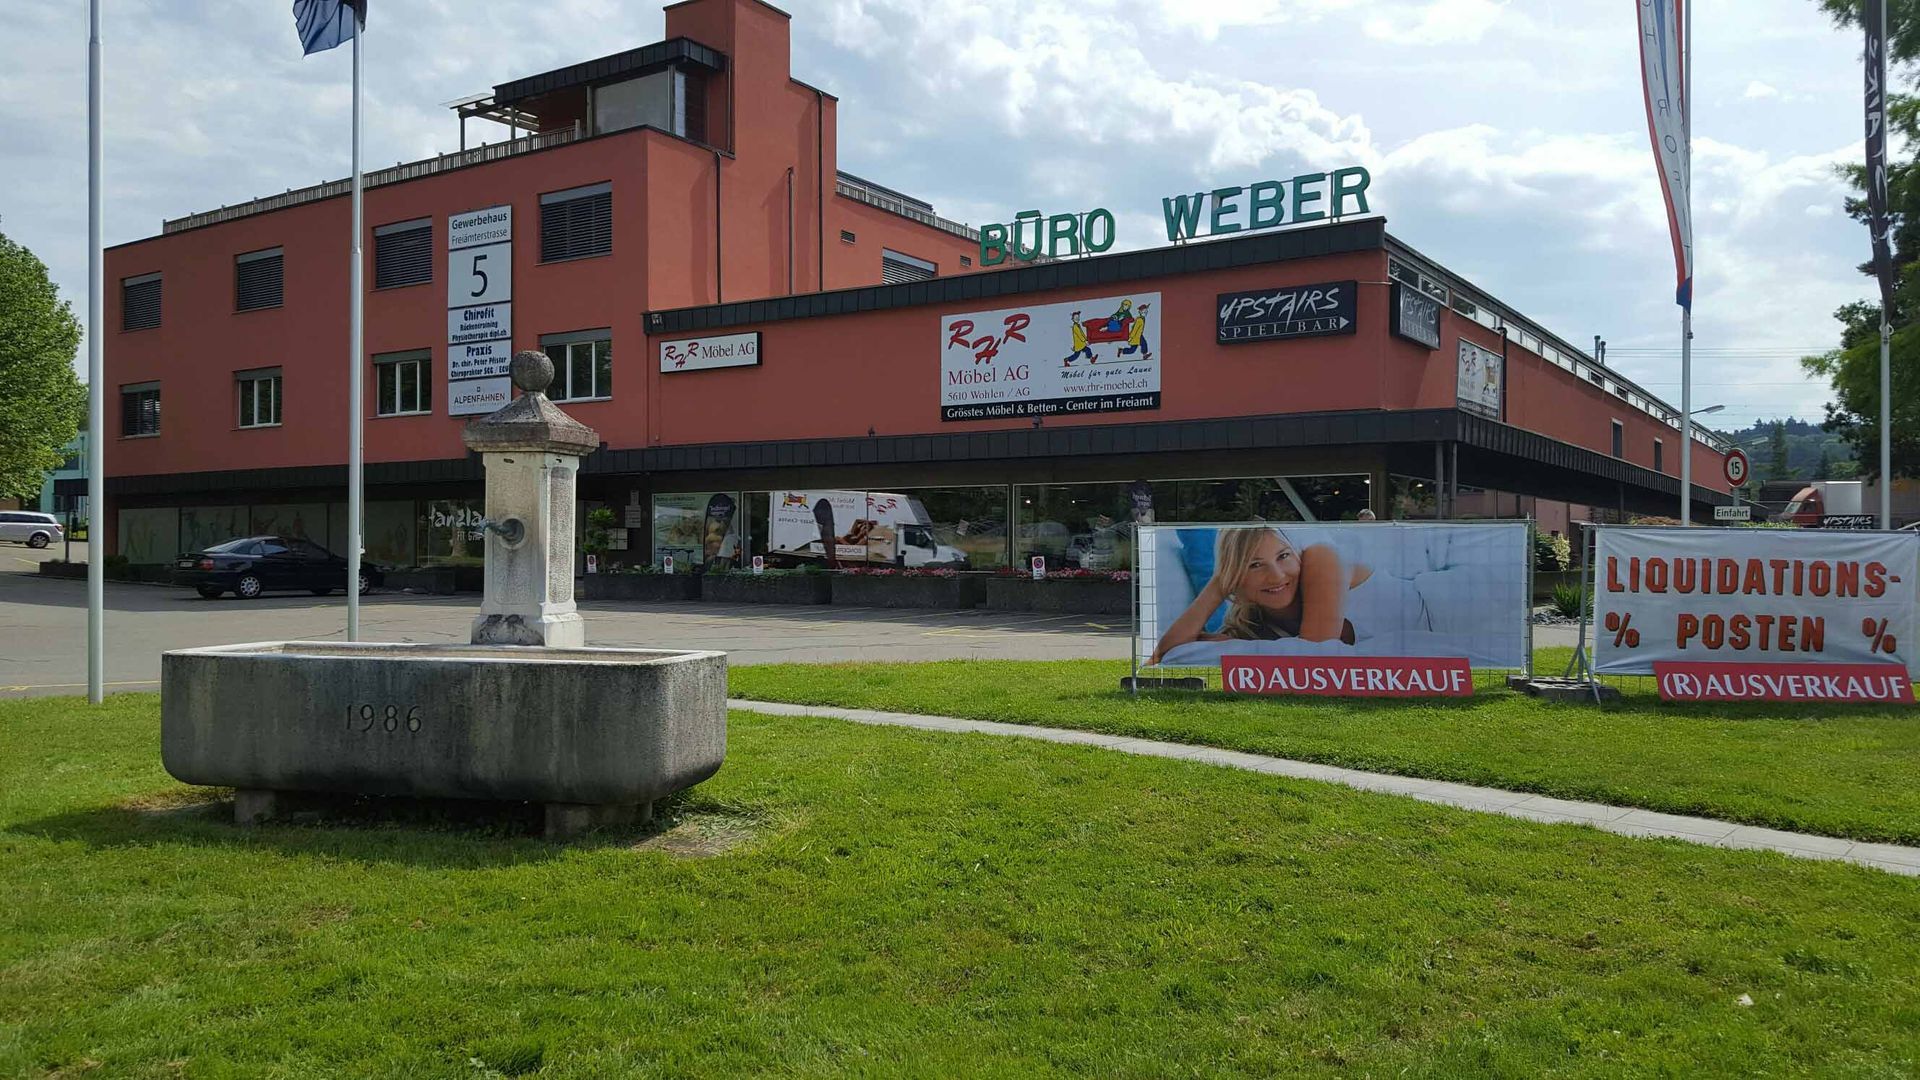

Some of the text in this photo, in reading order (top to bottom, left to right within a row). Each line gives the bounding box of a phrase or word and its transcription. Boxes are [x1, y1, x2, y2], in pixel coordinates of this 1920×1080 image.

[1162, 166, 1371, 241] WEBER
[452, 213, 507, 230] Gewerbehaus
[452, 229, 508, 246] Freiämterstrasse
[471, 254, 488, 298] 5
[463, 307, 495, 321] Chirofit
[1220, 286, 1340, 332] UPSTAIRS
[1220, 319, 1337, 339] SPIEL BAR
[466, 344, 492, 357] Praxis
[702, 344, 734, 359] Möbel
[737, 341, 755, 356] AG
[474, 358, 488, 366] Peter
[948, 364, 1029, 385] Möbel AG
[1061, 366, 1152, 379] Möbel für gute Laune
[948, 391, 968, 401] 5610
[970, 388, 1004, 400] Wohlen
[1015, 387, 1030, 397] AG
[1063, 378, 1148, 393] www.rhr-moebel.ch
[454, 392, 505, 405] ALPENFAHNEN
[947, 407, 984, 418] Grösstes
[986, 404, 1015, 416] Möbel
[1016, 403, 1025, 413] &
[1027, 402, 1057, 414] Betten
[1066, 400, 1098, 411] Center
[1100, 398, 1113, 409] im
[1116, 396, 1153, 408] Freiamt
[1731, 461, 1740, 475] 15
[428, 504, 485, 528] tanzla
[1716, 508, 1749, 519] Einfahrt
[1823, 516, 1873, 528] UPSTAIRS
[1607, 556, 1901, 597] LIQUIDATIONS-
[1605, 611, 1897, 654] % POSTEN %
[1228, 667, 1466, 693] (R)AUSVERKAUF
[1663, 673, 1905, 699] (R)AUSVERKAUF
[346, 704, 422, 733] 1986
